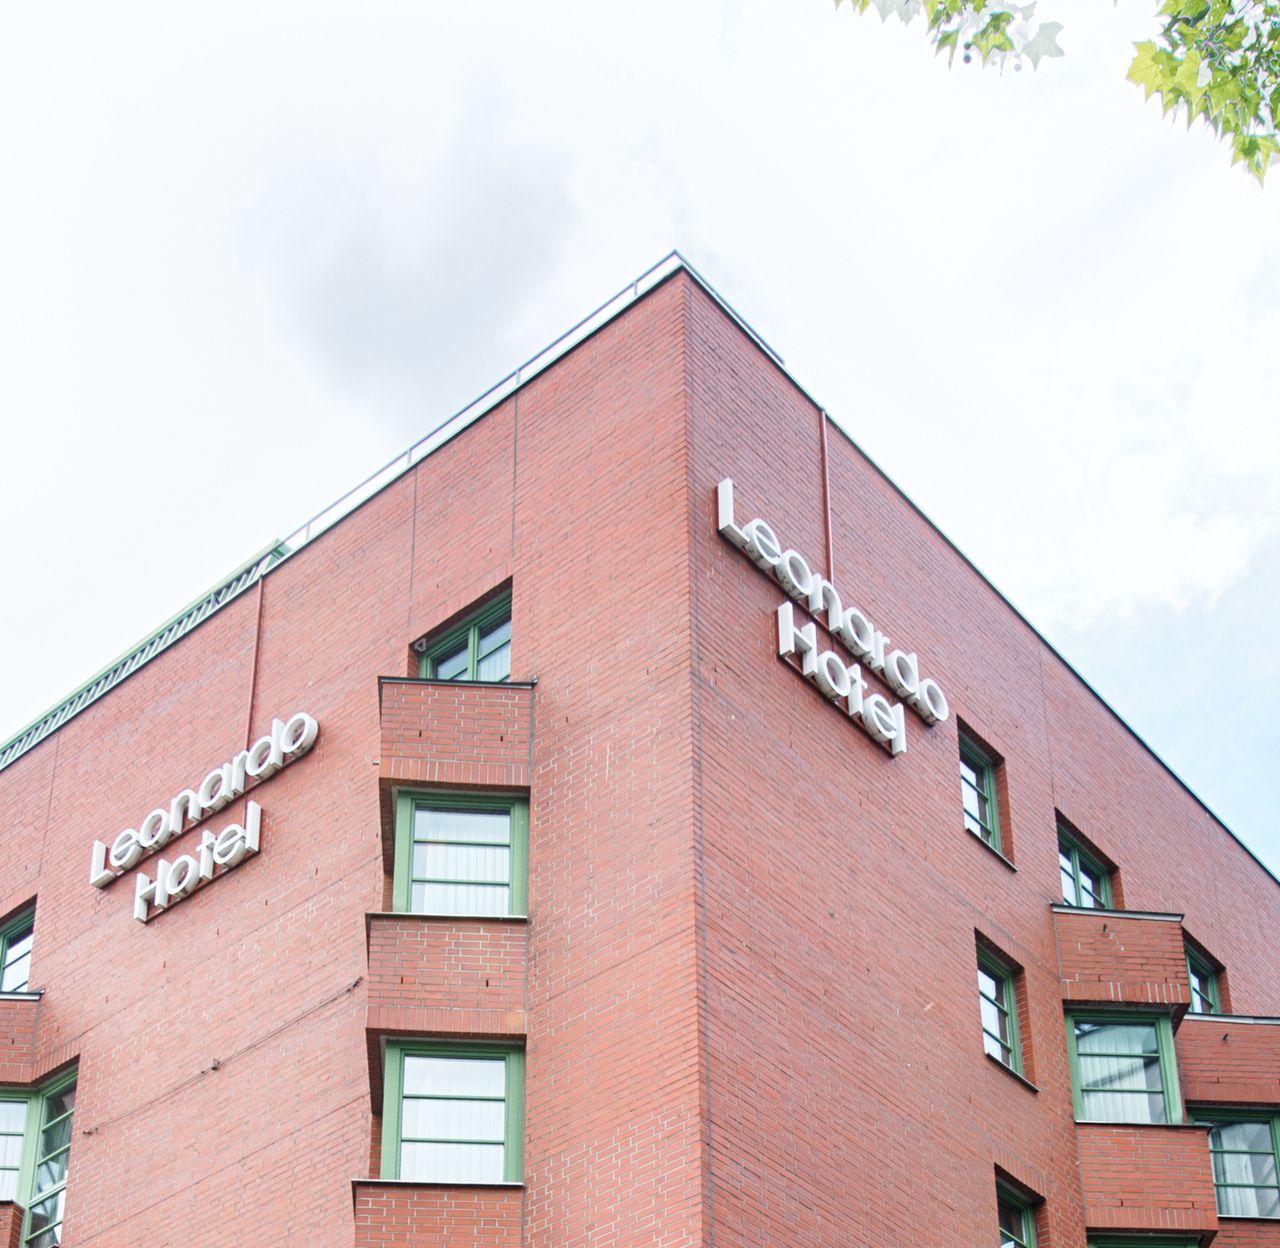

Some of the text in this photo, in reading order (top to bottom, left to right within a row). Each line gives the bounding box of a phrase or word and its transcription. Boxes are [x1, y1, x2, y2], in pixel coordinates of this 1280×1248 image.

[717, 478, 949, 726] Leonardo
[777, 601, 907, 757] Hotel
[90, 712, 319, 889] Leonardo
[134, 800, 261, 923] Hotel
